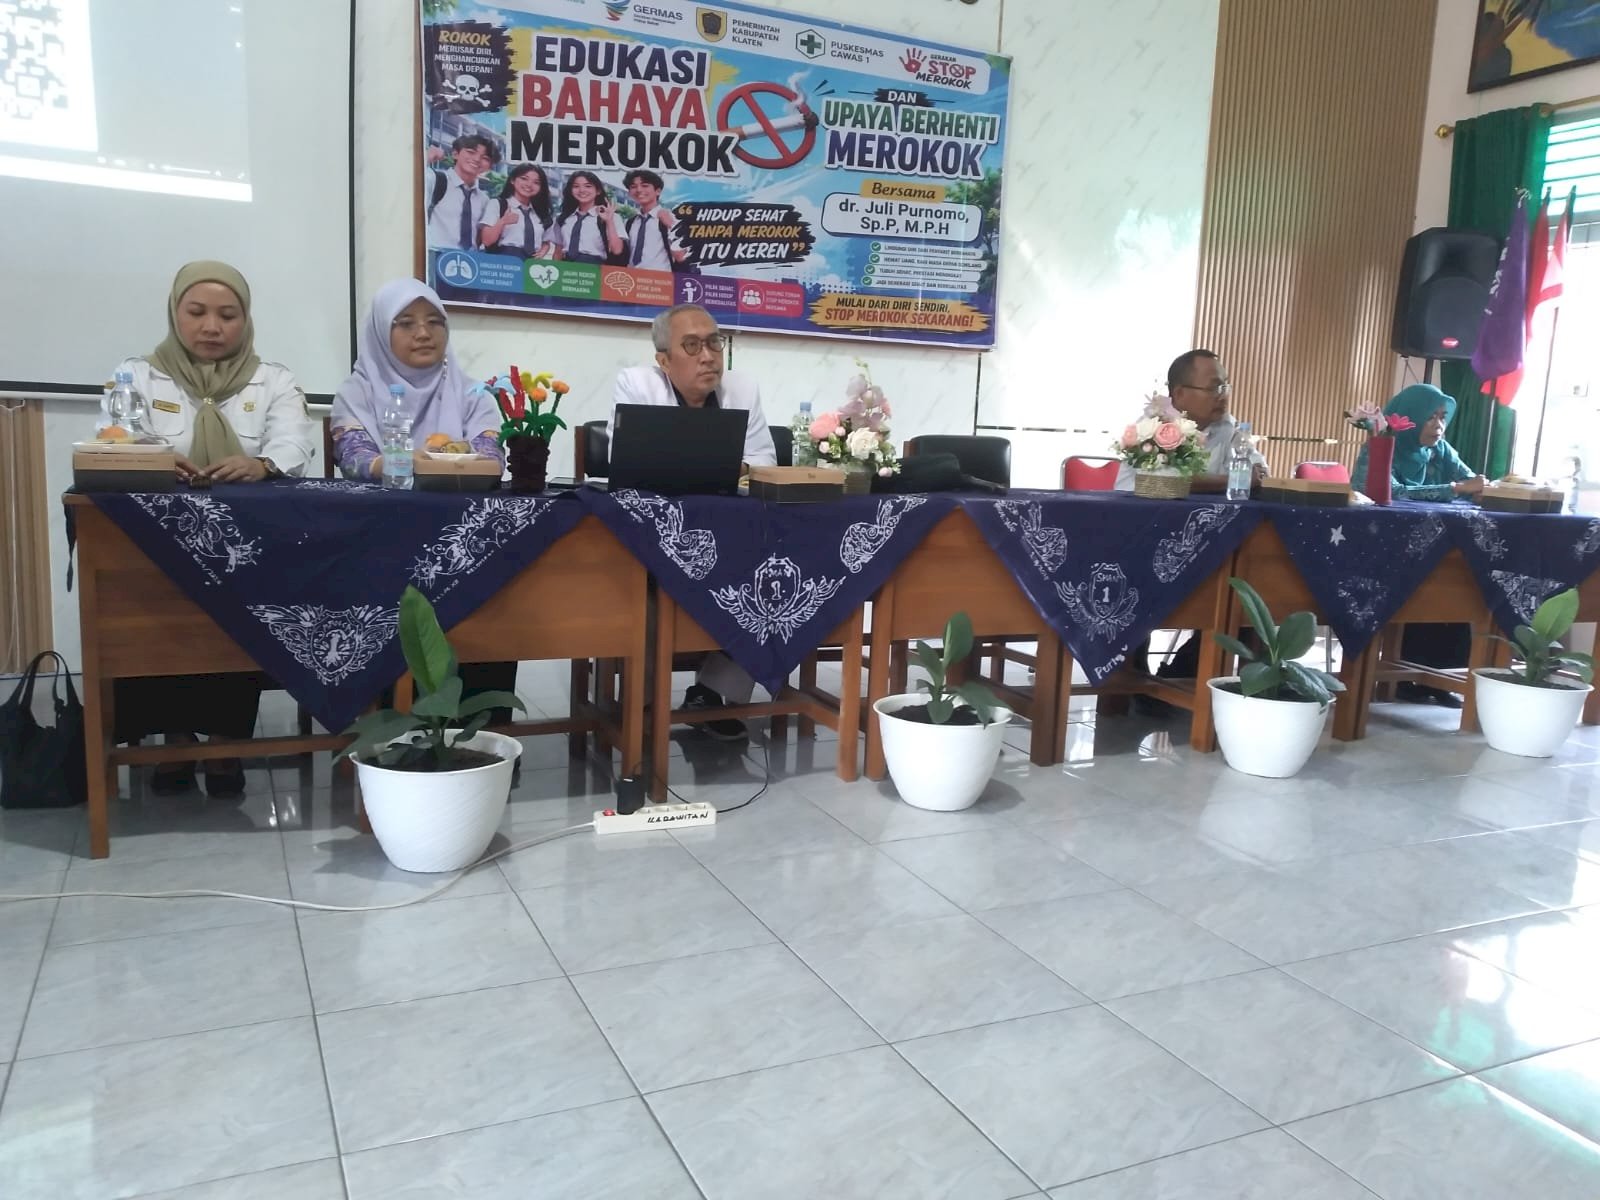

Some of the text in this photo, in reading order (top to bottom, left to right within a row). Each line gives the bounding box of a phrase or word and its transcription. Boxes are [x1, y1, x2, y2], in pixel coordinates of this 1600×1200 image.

[633, 5, 683, 21] GERMAS
[732, 19, 780, 34] PEMERINTAH
[732, 27, 779, 41] KABUPATEN
[439, 30, 491, 46] ROKOK
[732, 36, 762, 47] KLATEN
[439, 44, 474, 54] MERUSAK
[830, 50, 863, 62] CAWAS
[831, 41, 884, 57] PUSKESMAS
[434, 54, 500, 65] MENGHANCURKAN
[535, 36, 707, 86] EDUKASI
[930, 54, 957, 62] GERAKAN
[441, 63, 493, 73] MASA DEPAN!
[928, 60, 976, 79] STOP
[916, 72, 972, 89] MEROKOK
[522, 73, 706, 130] BAHAYA
[887, 90, 917, 104] DAN
[823, 100, 998, 141] UPAYA BERHENTI
[511, 120, 734, 173] MEROKOK
[827, 129, 983, 177] MEROKOK
[872, 182, 936, 199] Bersama
[744, 208, 788, 222] SEHAT
[839, 199, 969, 224] dr. Juli Purnomo,
[689, 225, 802, 238] TANPA MEROKOK
[860, 217, 950, 235] Sp.P, M.P.H
[700, 242, 731, 259] ITU
[836, 297, 866, 308] MULAI
[868, 299, 890, 310] DARI
[893, 302, 912, 311] DIRI
[825, 308, 974, 327] STOP MEROKOK SEKARANG!
